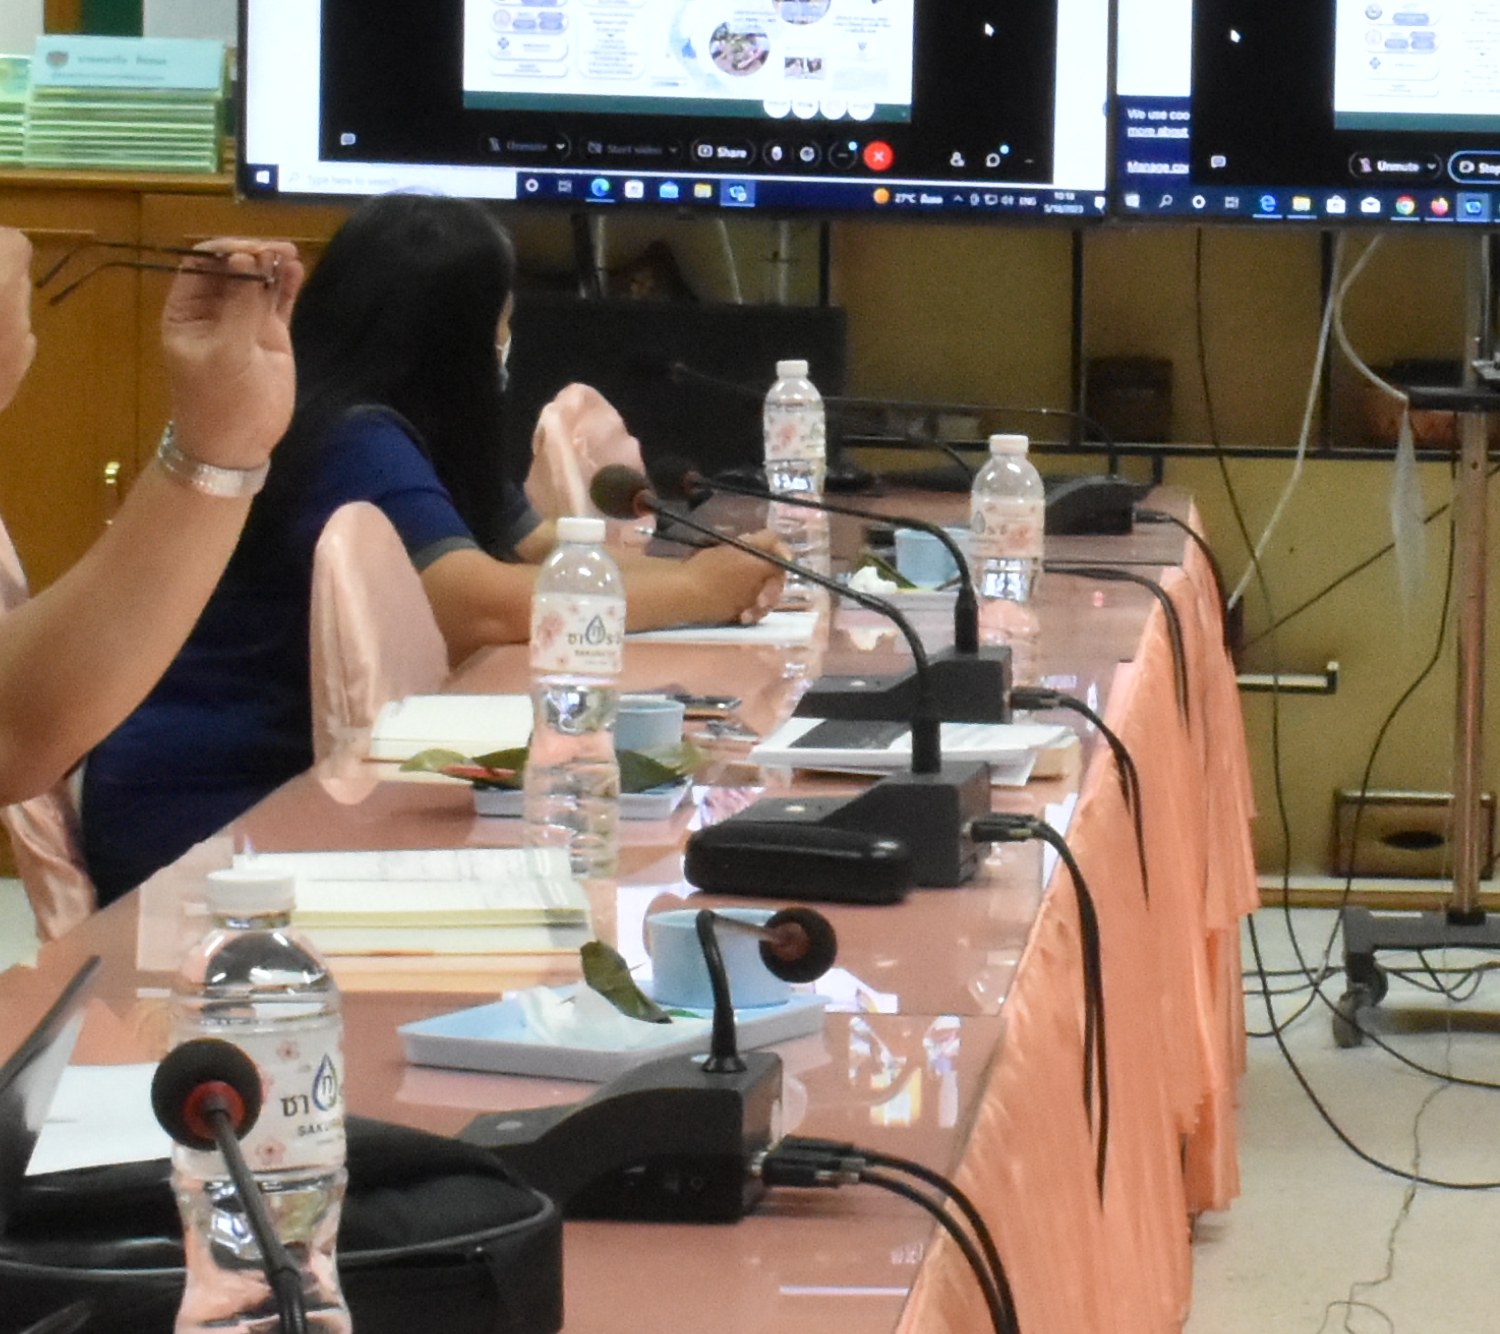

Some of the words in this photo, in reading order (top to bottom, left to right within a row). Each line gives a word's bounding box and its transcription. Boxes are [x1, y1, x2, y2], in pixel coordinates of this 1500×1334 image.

[1126, 109, 1146, 120] We
[1147, 110, 1168, 121] use
[716, 146, 748, 159] Share
[1377, 160, 1420, 173] Unmute
